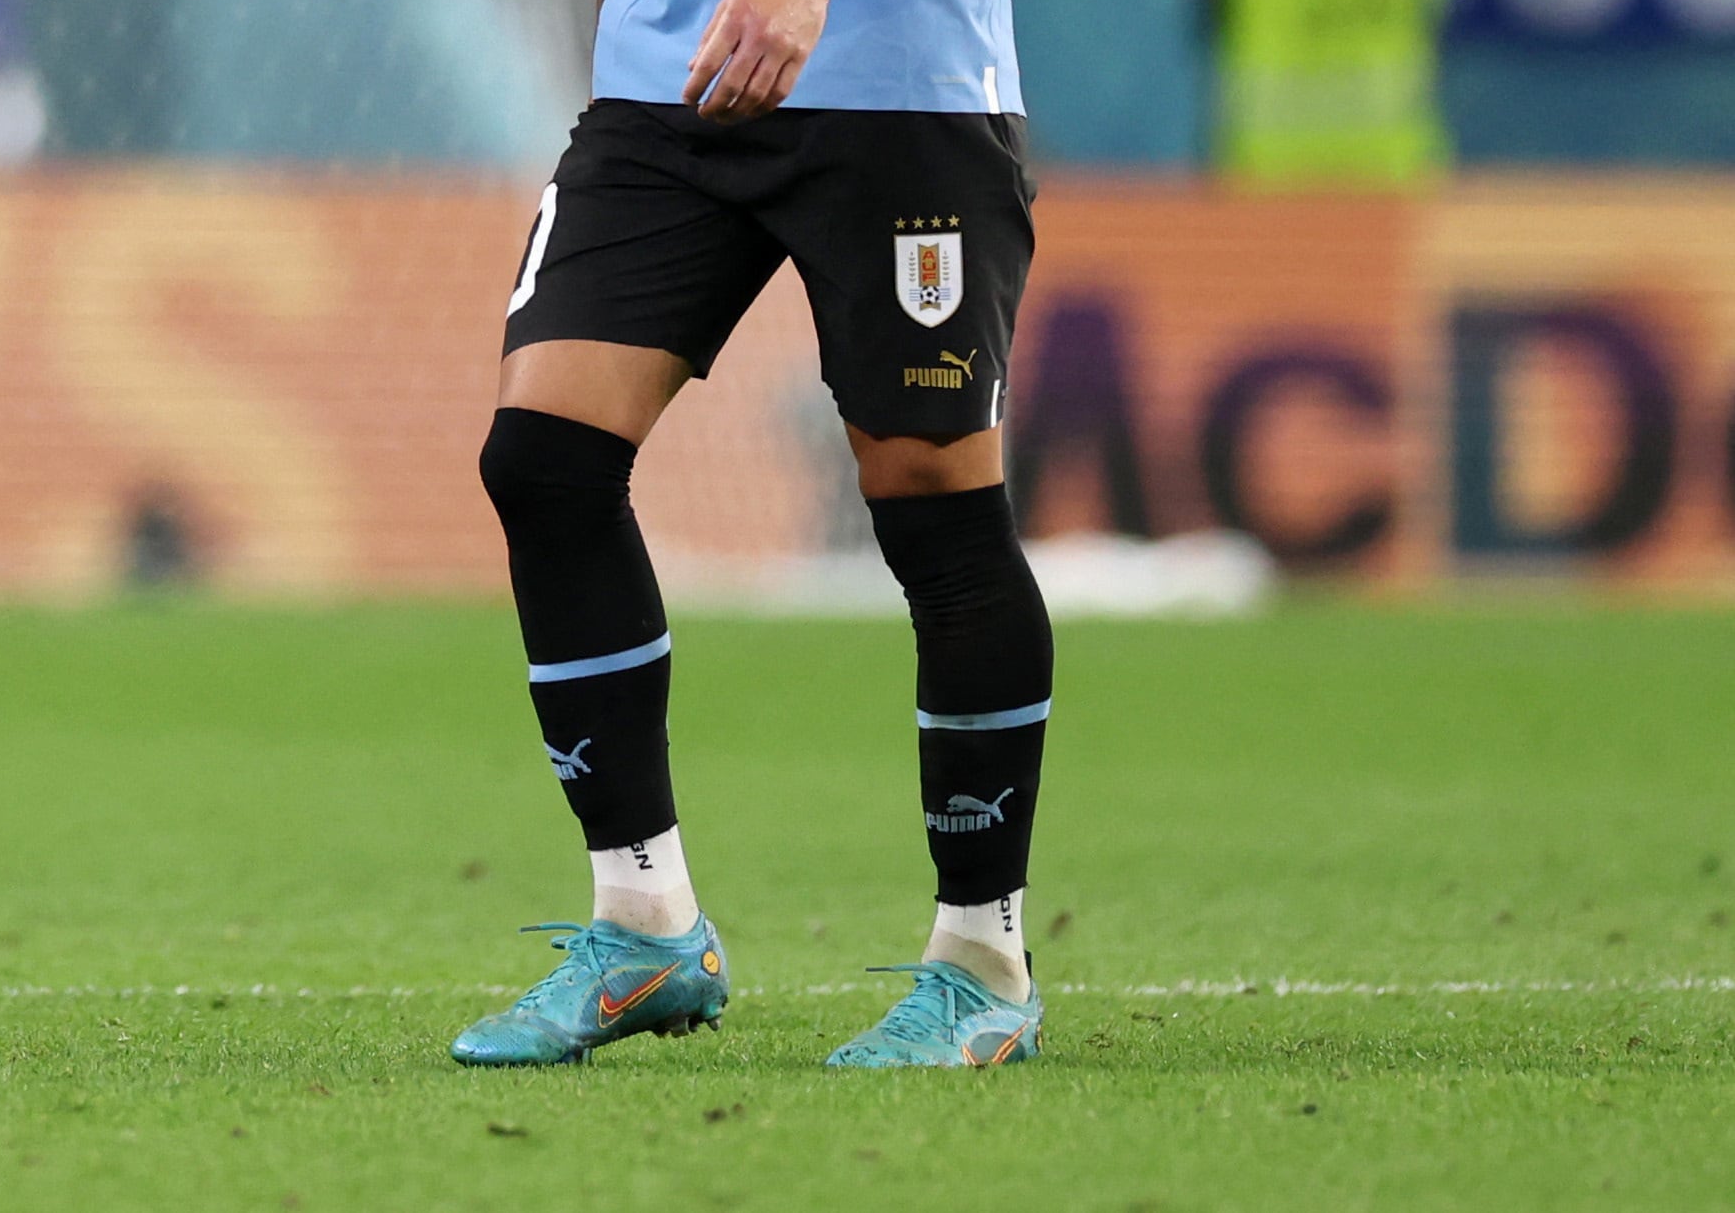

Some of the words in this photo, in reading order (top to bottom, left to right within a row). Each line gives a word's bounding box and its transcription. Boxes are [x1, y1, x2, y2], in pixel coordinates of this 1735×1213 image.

[921, 250, 937, 282] AUF
[904, 368, 962, 389] PUMA
[925, 811, 992, 833] PUMA
